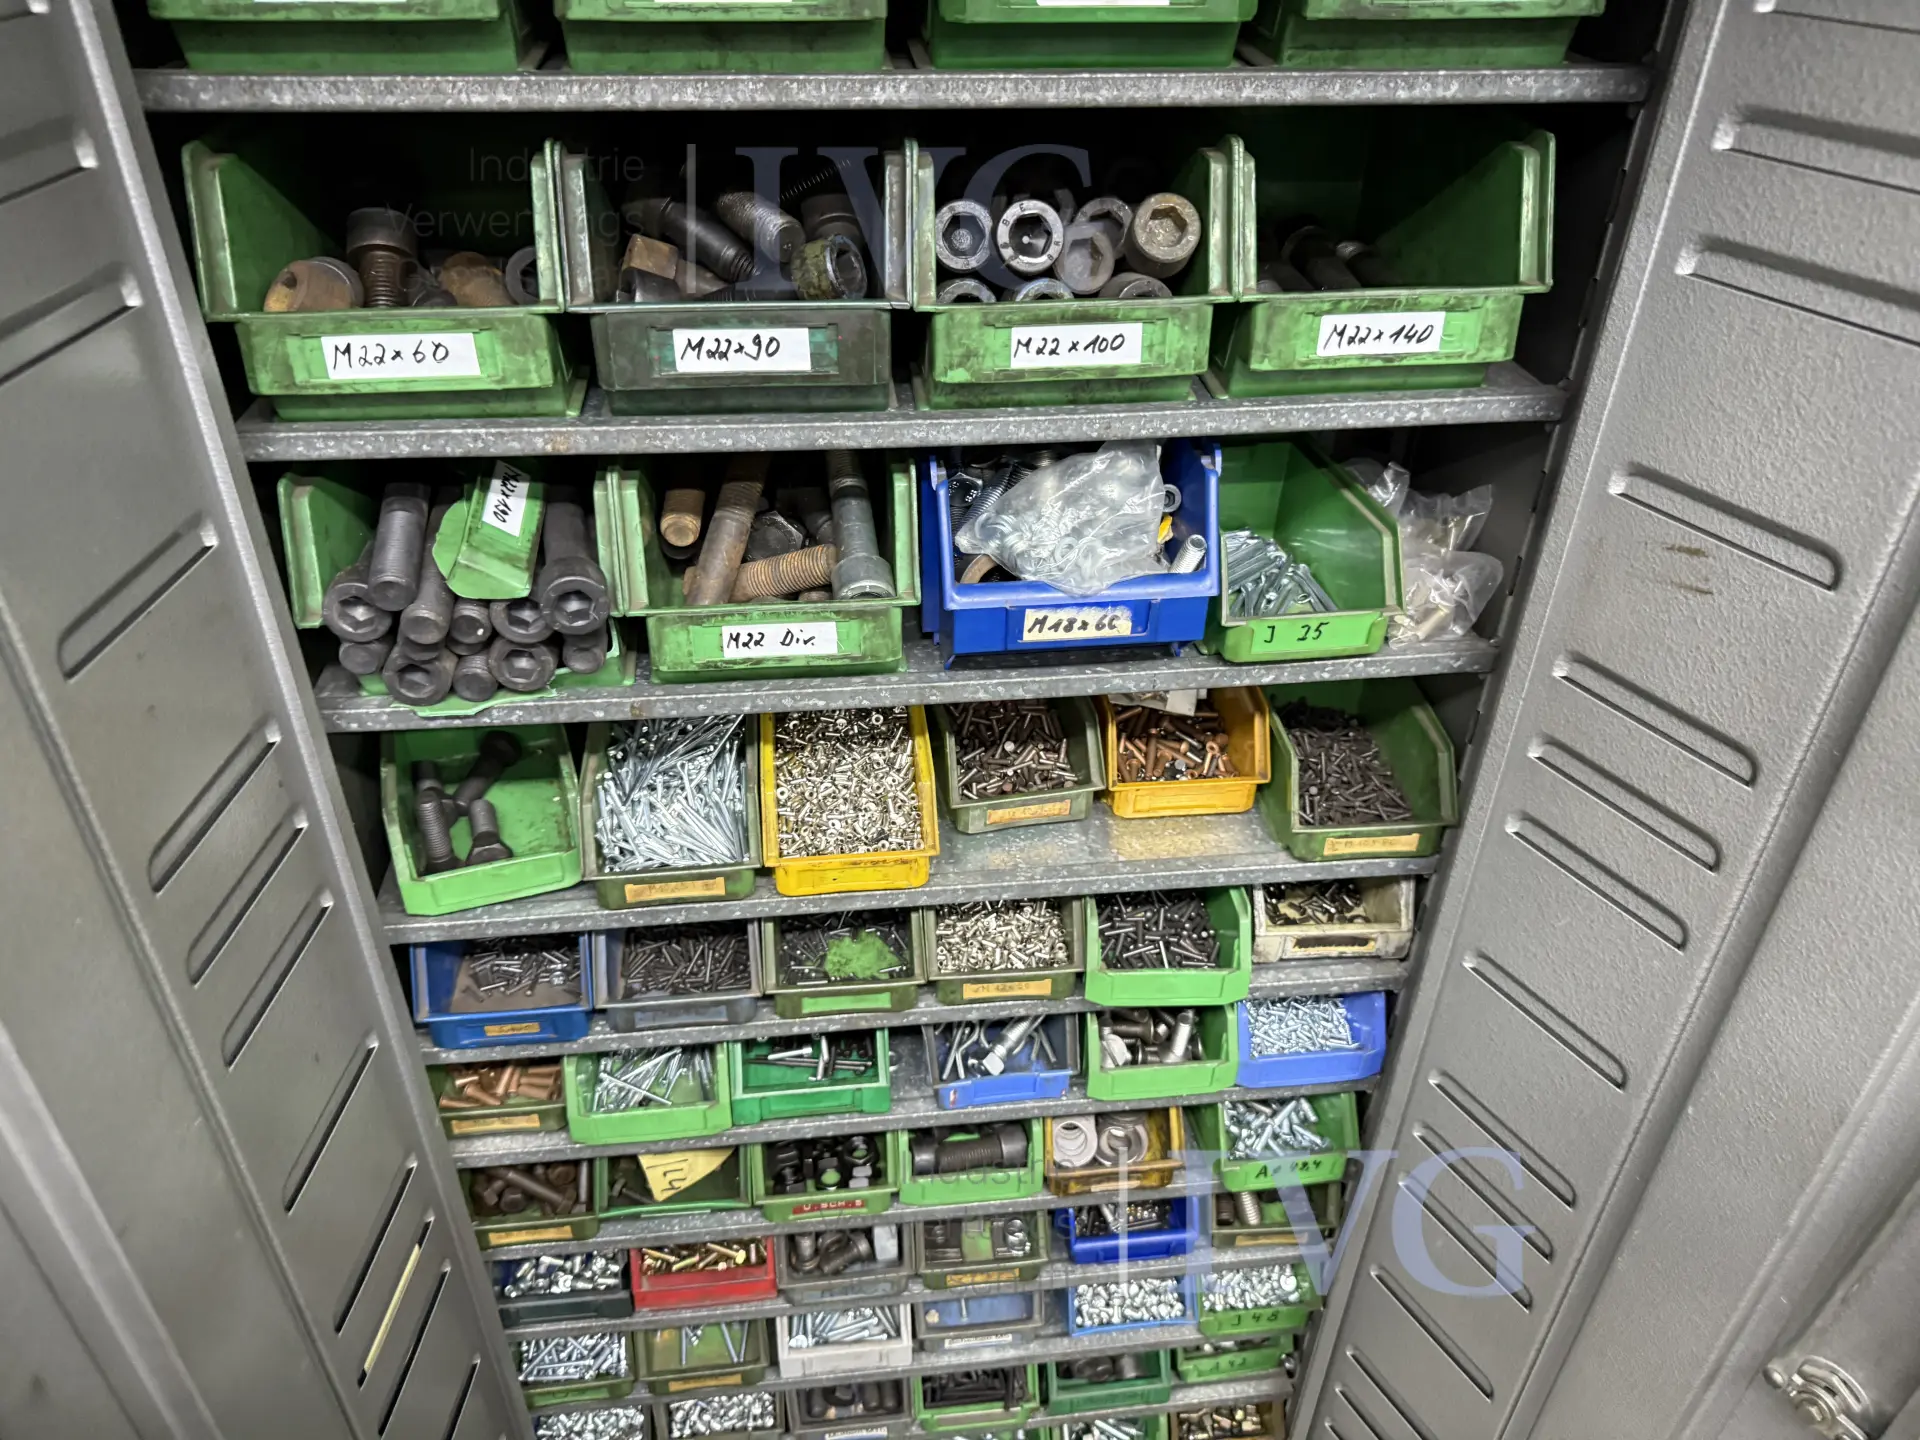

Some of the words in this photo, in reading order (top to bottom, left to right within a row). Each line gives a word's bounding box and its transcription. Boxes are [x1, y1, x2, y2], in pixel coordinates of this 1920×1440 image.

[680, 333, 780, 361] M22x90
[1323, 324, 1434, 350] M22x140
[727, 631, 765, 649] M22
